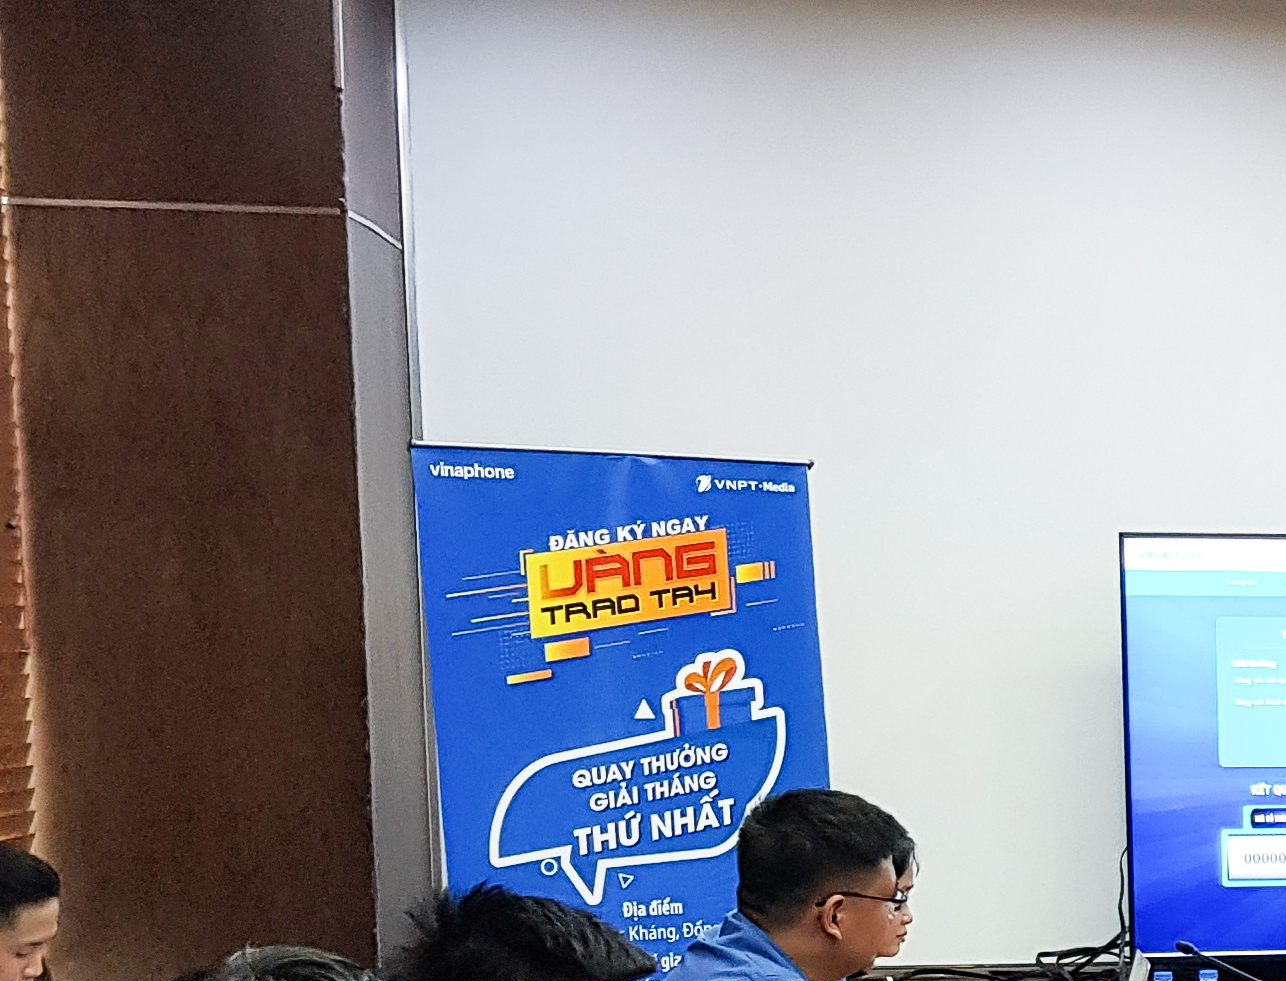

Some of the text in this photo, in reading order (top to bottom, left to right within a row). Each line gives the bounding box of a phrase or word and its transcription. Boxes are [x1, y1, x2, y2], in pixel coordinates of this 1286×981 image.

[430, 462, 515, 480] vinaphone
[549, 515, 709, 551] ĐĂNG KÝ NGAY
[572, 743, 729, 788] QUAY THƯỞNG
[589, 771, 717, 812] GIẢI THÁNG
[573, 789, 735, 856] THỨ NHẤT
[622, 901, 647, 921] Địa
[628, 924, 680, 943] Kháng,
